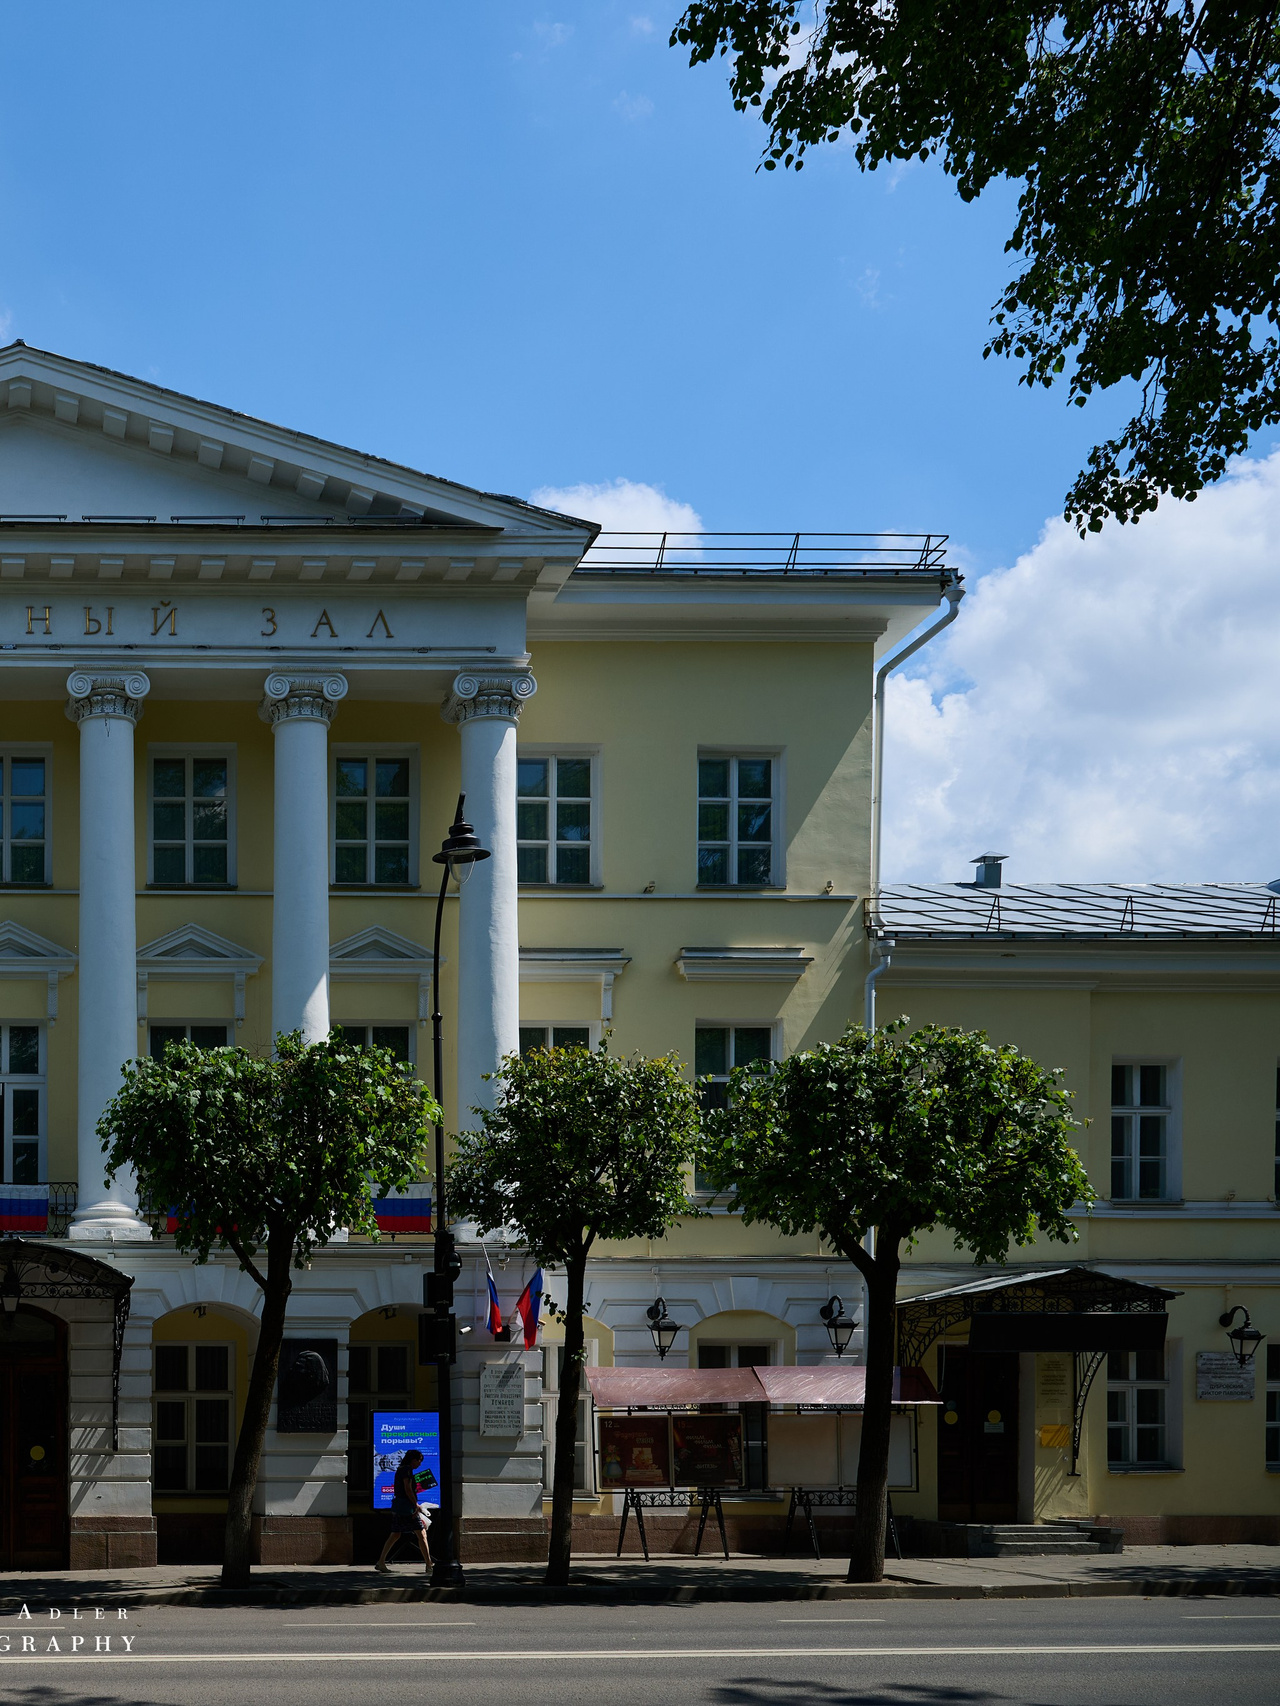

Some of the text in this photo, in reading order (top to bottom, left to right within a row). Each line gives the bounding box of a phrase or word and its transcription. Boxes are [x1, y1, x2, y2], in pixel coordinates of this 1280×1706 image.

[260, 607, 394, 639] ЗАЛ
[380, 1424, 406, 1432] Души
[381, 1437, 424, 1445] порывы?
